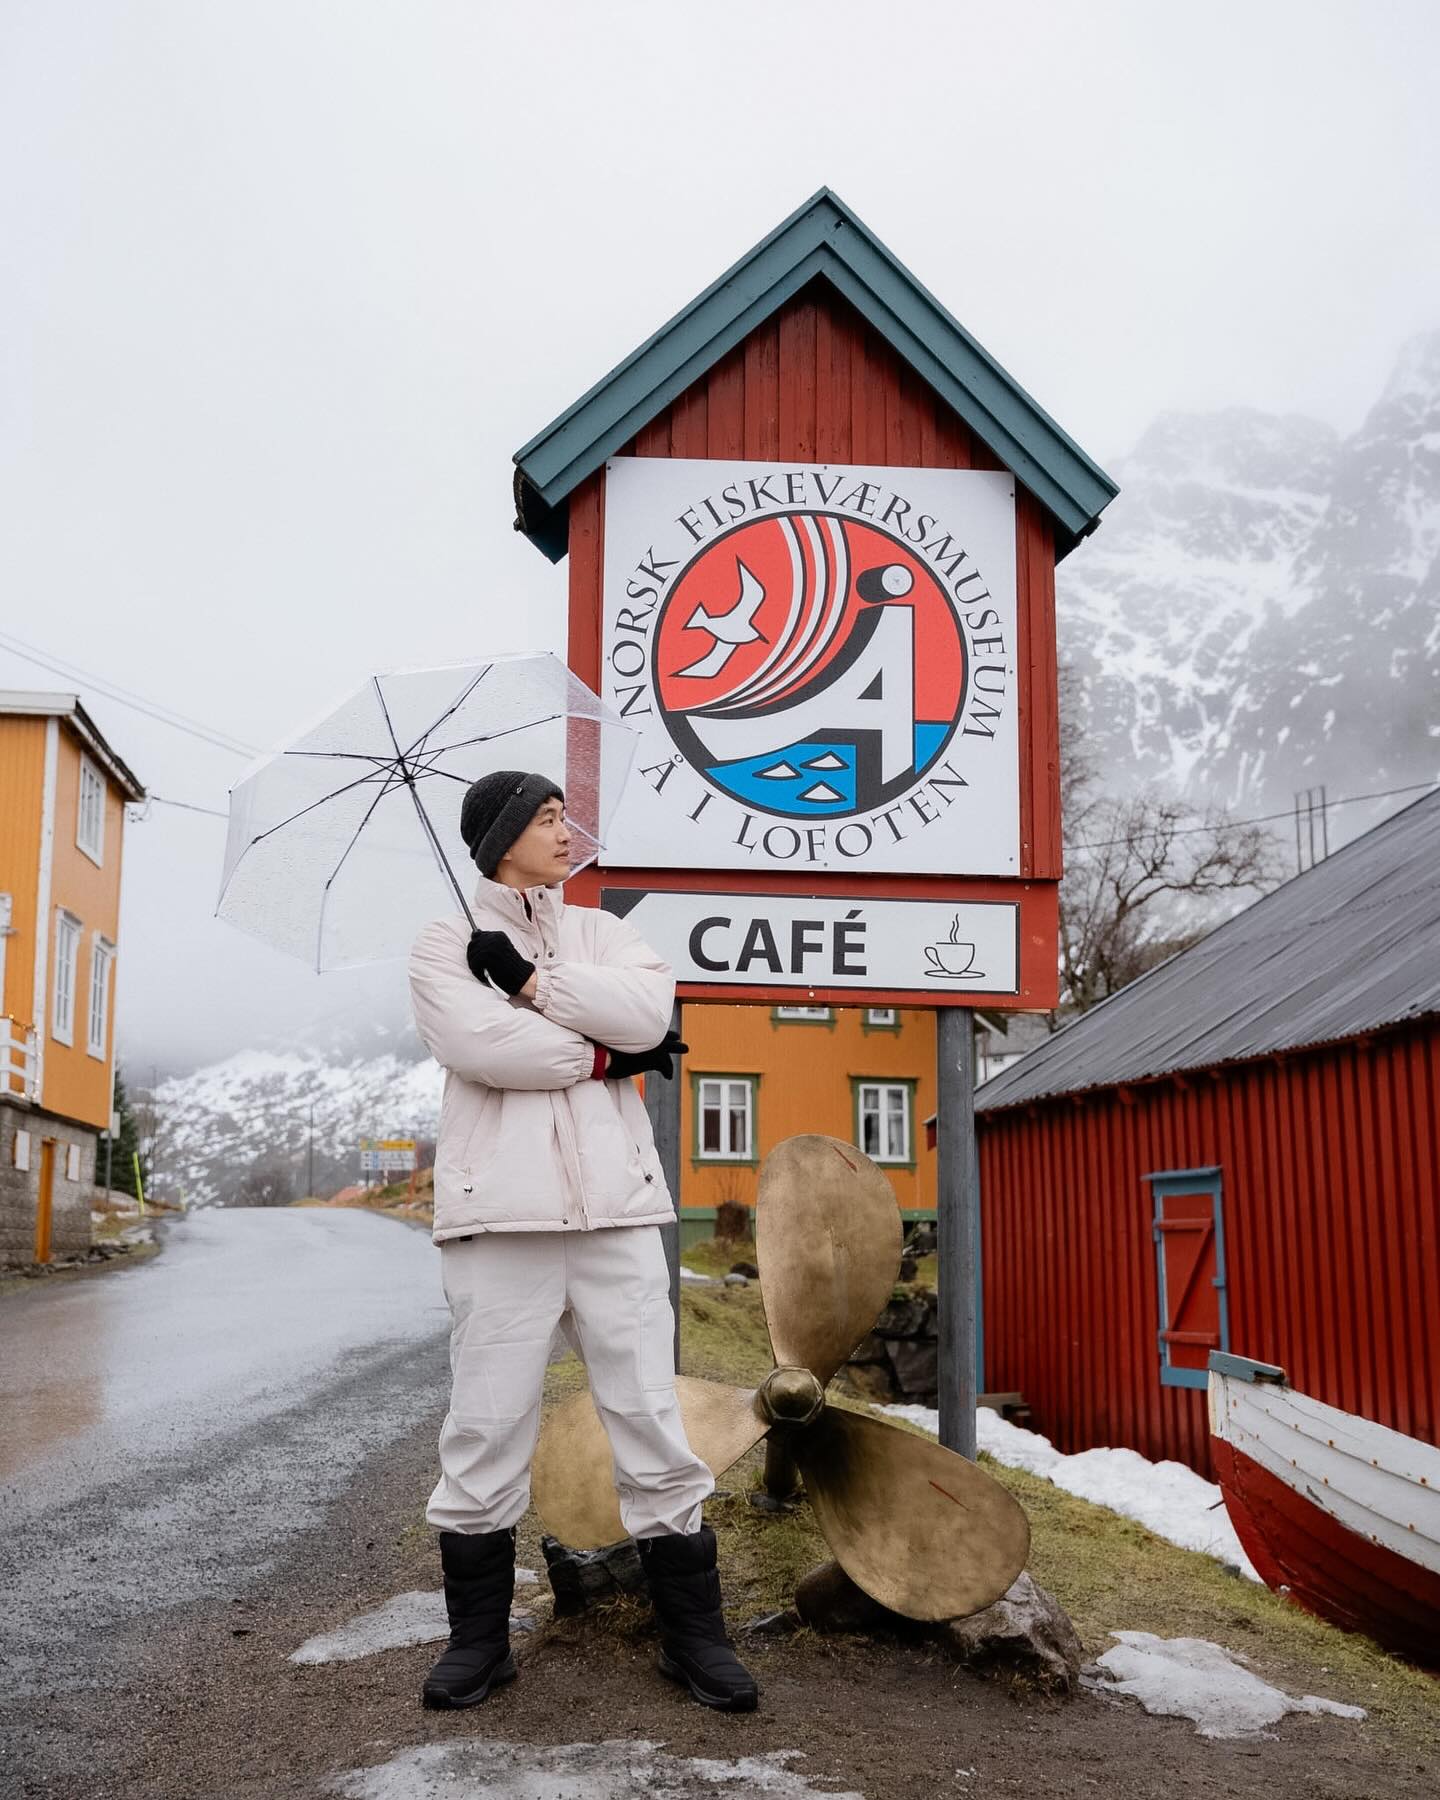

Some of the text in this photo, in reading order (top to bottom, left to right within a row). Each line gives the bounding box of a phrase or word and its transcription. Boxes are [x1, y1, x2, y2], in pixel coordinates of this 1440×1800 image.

[612, 472, 1007, 741] NORSK FISKEVÆRSMUSEUM
[640, 753, 970, 862] Å I LOFOTEN
[688, 909, 868, 977] CAFÉ
